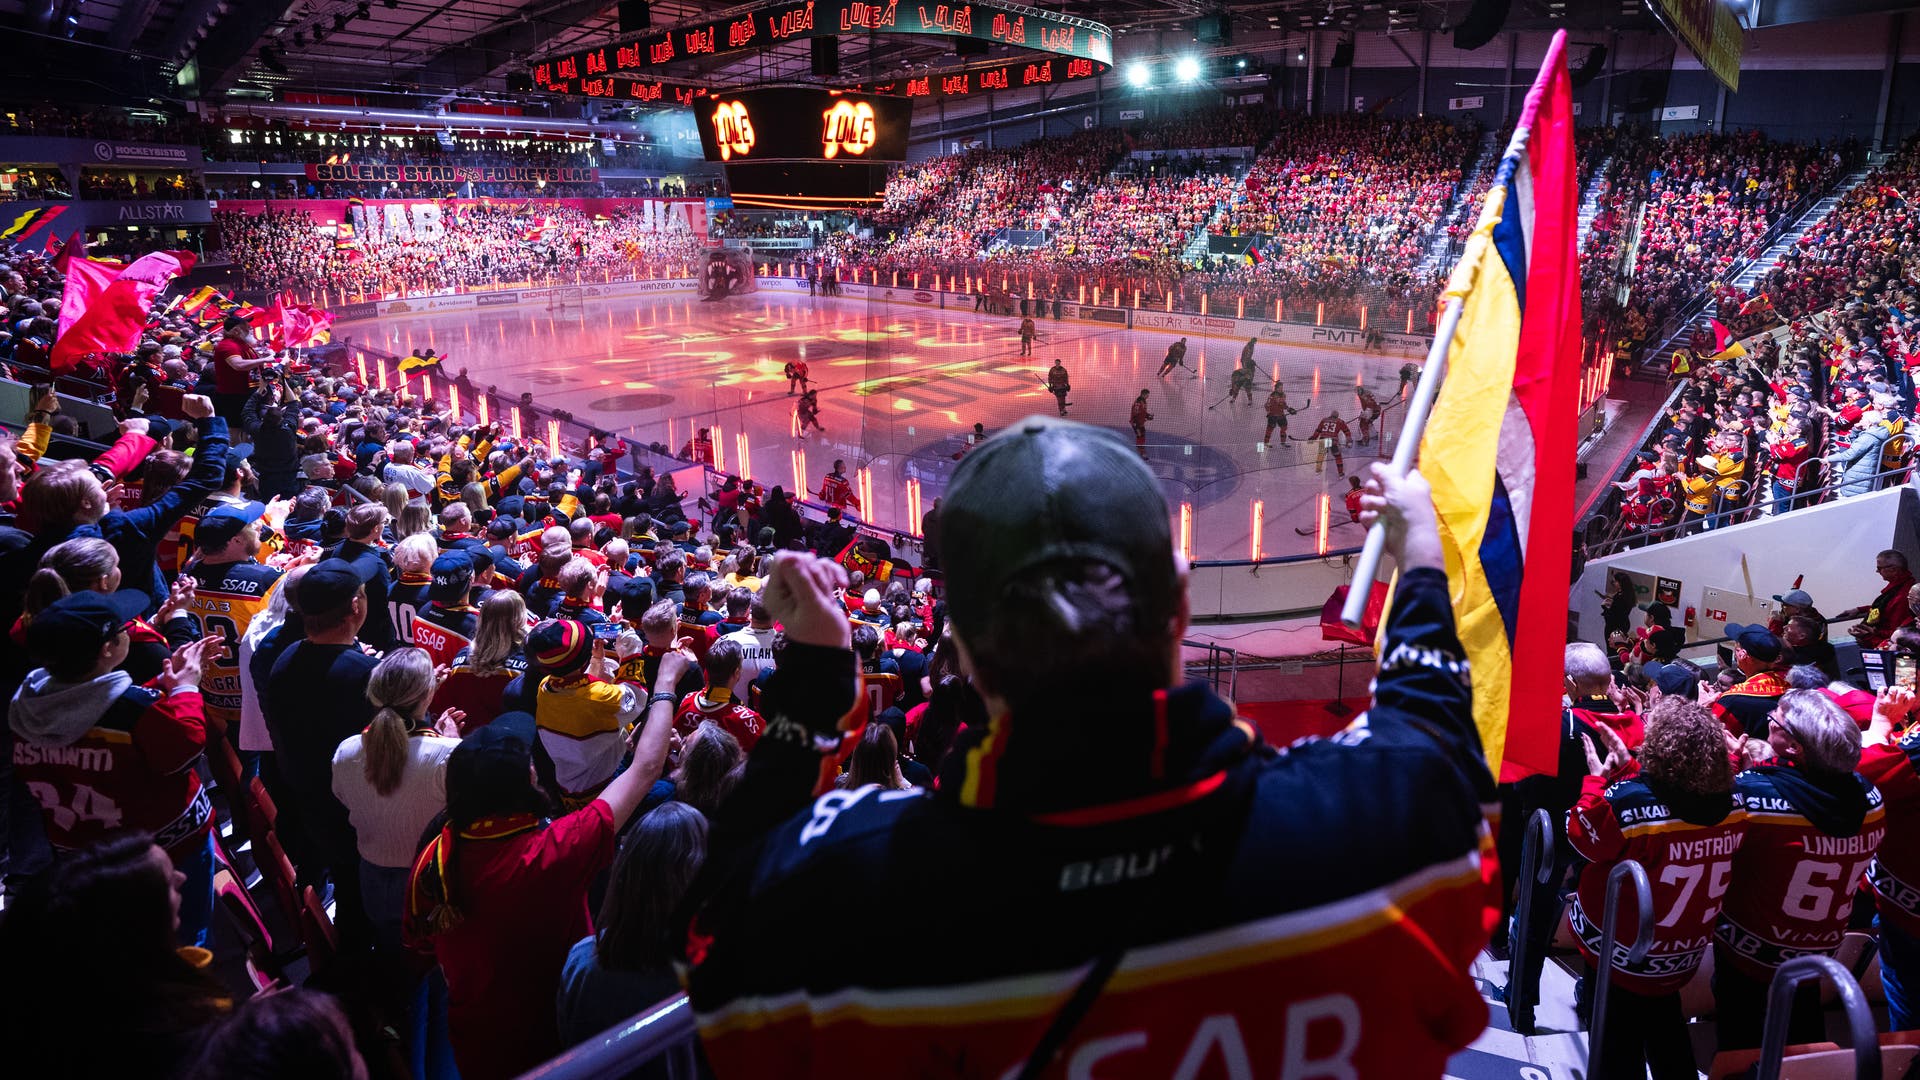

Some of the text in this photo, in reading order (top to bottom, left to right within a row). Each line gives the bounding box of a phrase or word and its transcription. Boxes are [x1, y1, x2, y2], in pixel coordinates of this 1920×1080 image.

[770, 0, 815, 38] LULEÅ
[839, 0, 897, 31] LULEÅ
[918, 6, 972, 34] LULEÅ
[992, 14, 1025, 43] LULEÅ
[714, 114, 751, 146] LULE
[823, 113, 873, 145] LULE
[115, 146, 186, 158] HOCKEYBISTRO
[316, 164, 399, 181] SOLENS
[404, 165, 455, 182] STAD
[482, 167, 559, 182] FOLKETS
[562, 168, 593, 182] LAG
[120, 203, 185, 220] ALLSTAR
[1135, 315, 1182, 329] ALLSTAR
[1312, 328, 1360, 344] PMT
[1322, 422, 1337, 433] 33
[220, 578, 258, 593] SSAB
[387, 601, 417, 644] 10
[416, 626, 447, 652] SSAB
[742, 648, 773, 660] VILAH
[684, 711, 718, 728] SSB
[732, 705, 760, 734] SSAB
[1633, 804, 1671, 820] LKAB
[1762, 798, 1795, 811] LKA
[1058, 844, 1173, 892] BAU
[1656, 860, 1732, 928] 75
[1867, 858, 1920, 909] SAB
[1771, 924, 1847, 942] VINA
